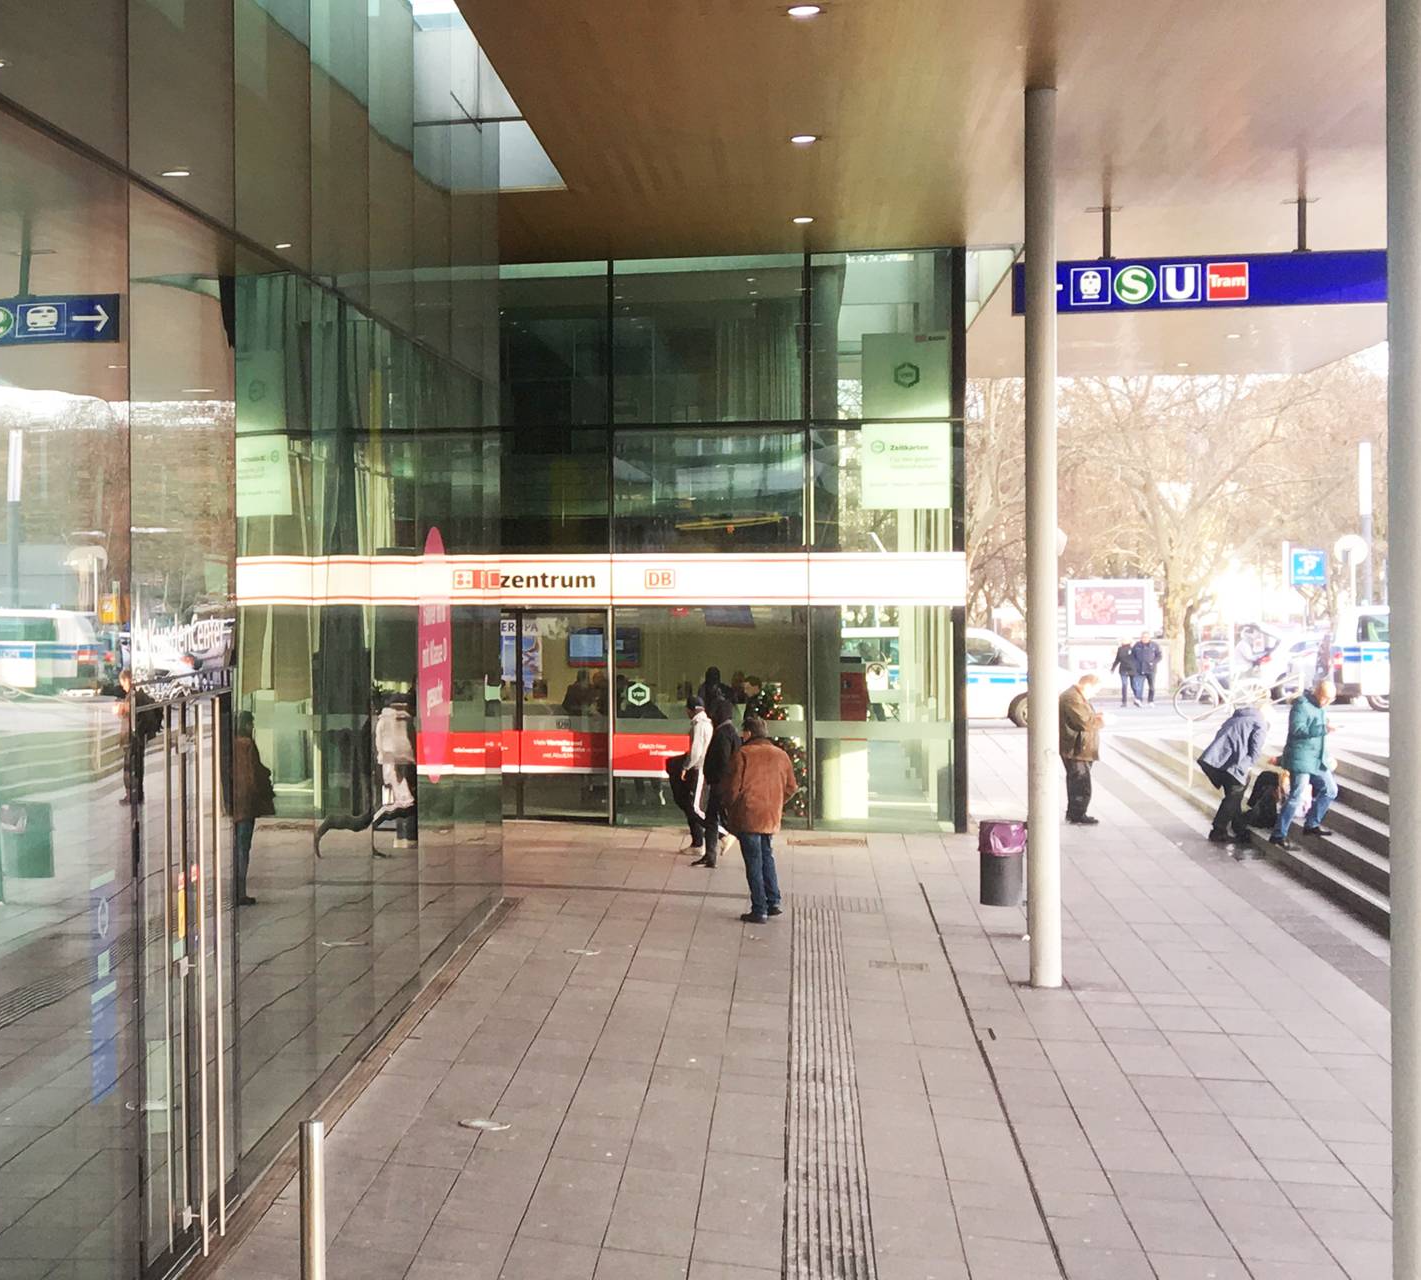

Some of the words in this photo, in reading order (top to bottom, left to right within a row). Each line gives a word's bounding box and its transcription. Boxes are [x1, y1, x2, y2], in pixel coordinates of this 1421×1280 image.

[1120, 269, 1154, 299] S
[1165, 267, 1193, 299] U
[1209, 274, 1246, 288] Tram
[500, 572, 596, 588] zentrum
[649, 572, 672, 586] DB
